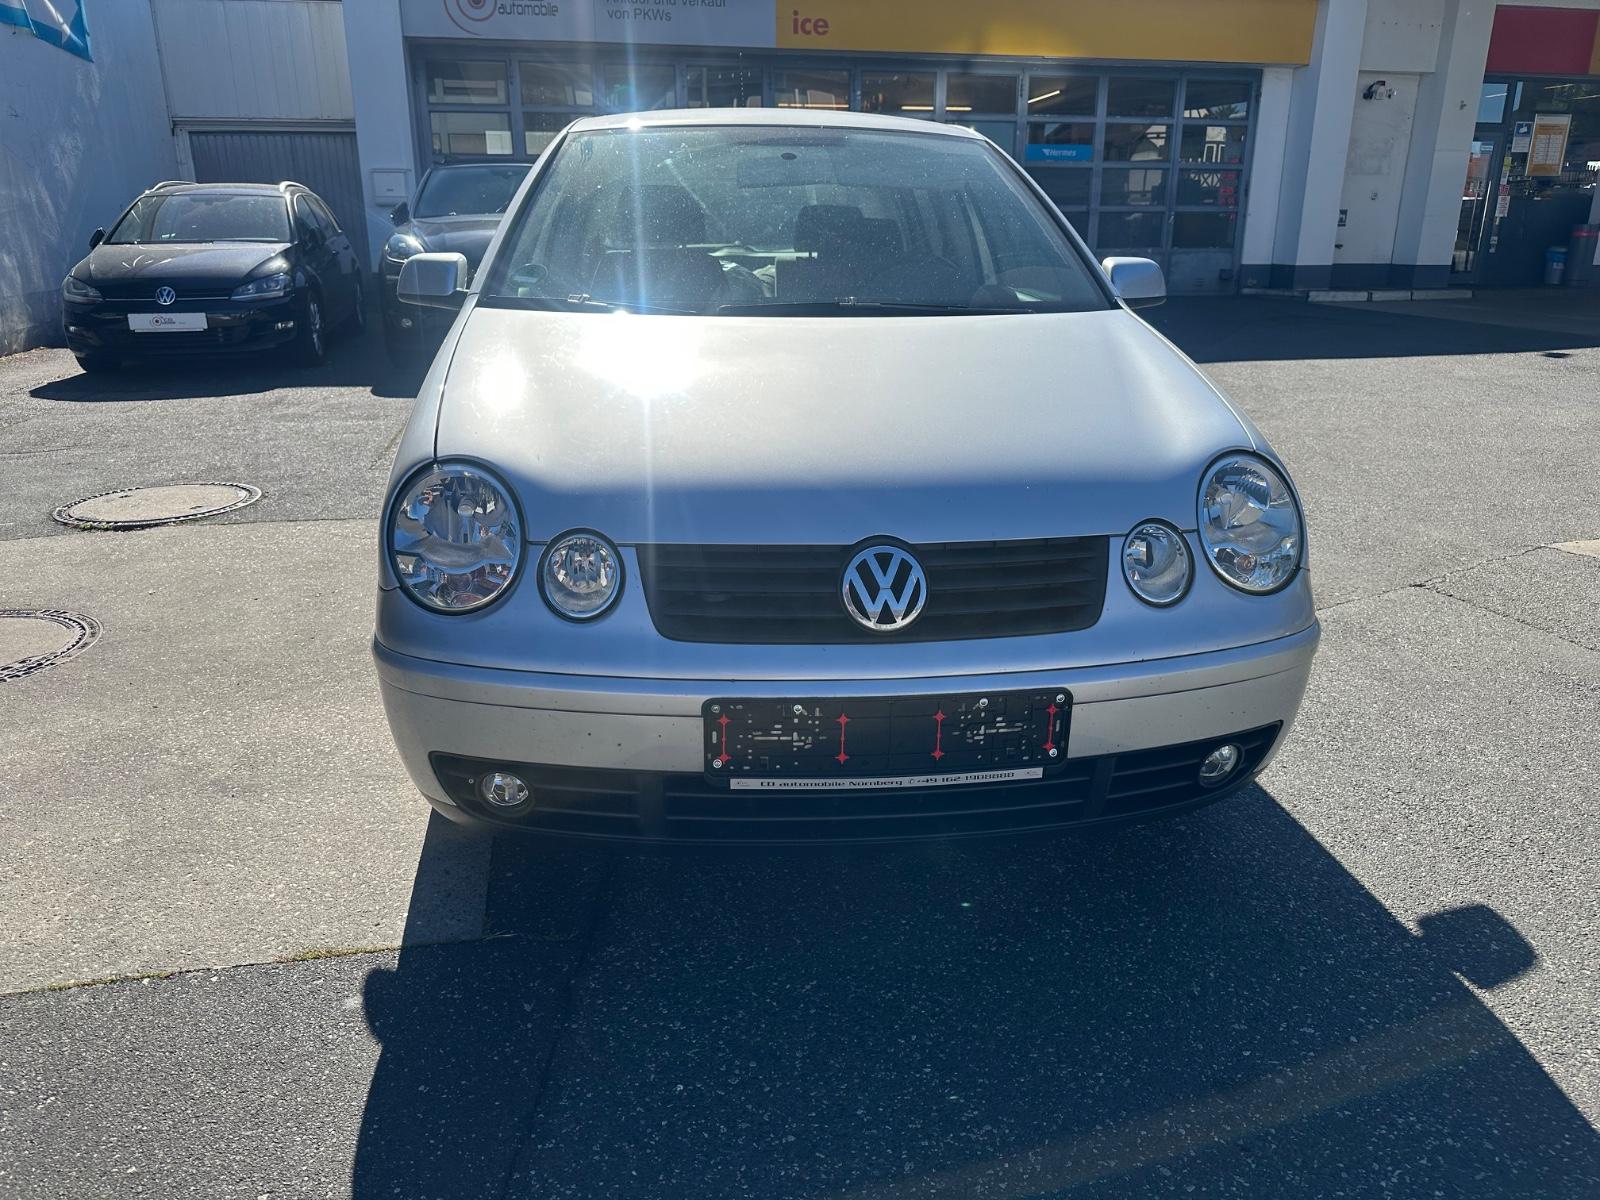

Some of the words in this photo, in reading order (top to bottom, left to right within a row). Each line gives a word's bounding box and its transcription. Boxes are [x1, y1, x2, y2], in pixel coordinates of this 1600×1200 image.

[498, 3, 559, 16] automobile
[607, 10, 630, 19] von
[634, 8, 672, 21] PKWs
[792, 9, 829, 36] ice
[842, 545, 927, 631] VW
